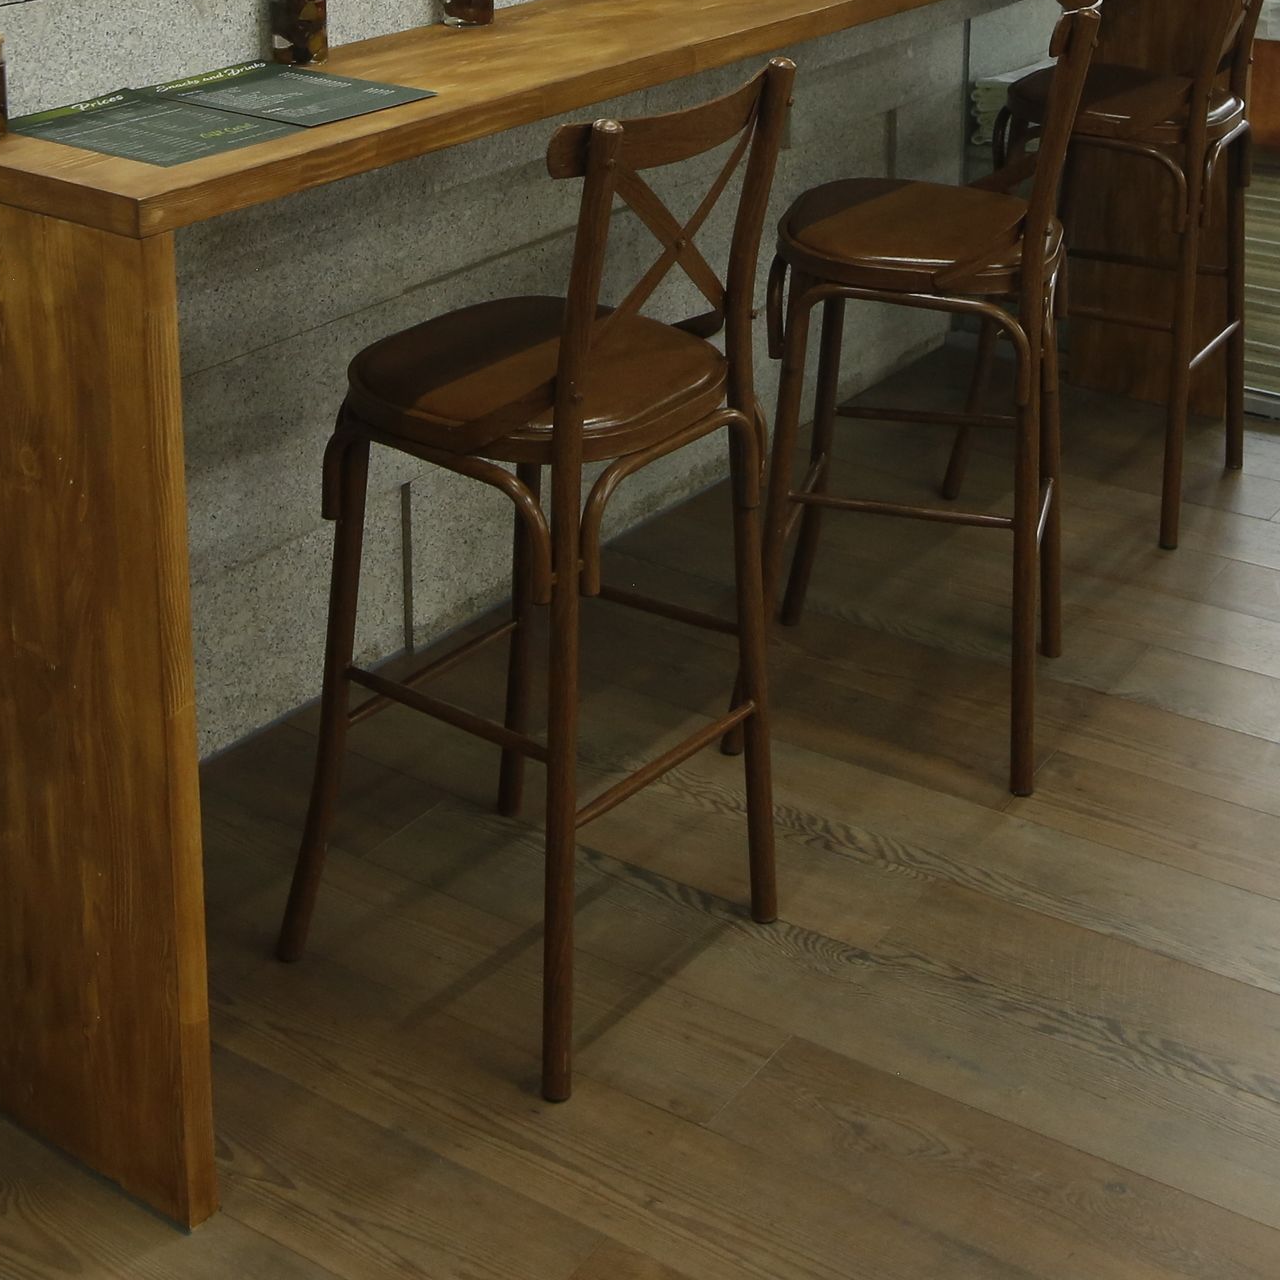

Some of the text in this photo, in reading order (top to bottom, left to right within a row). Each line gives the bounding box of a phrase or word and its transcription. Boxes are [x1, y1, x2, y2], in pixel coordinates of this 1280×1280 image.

[156, 62, 267, 93] Snacks and Drinks
[71, 95, 124, 111] Prices
